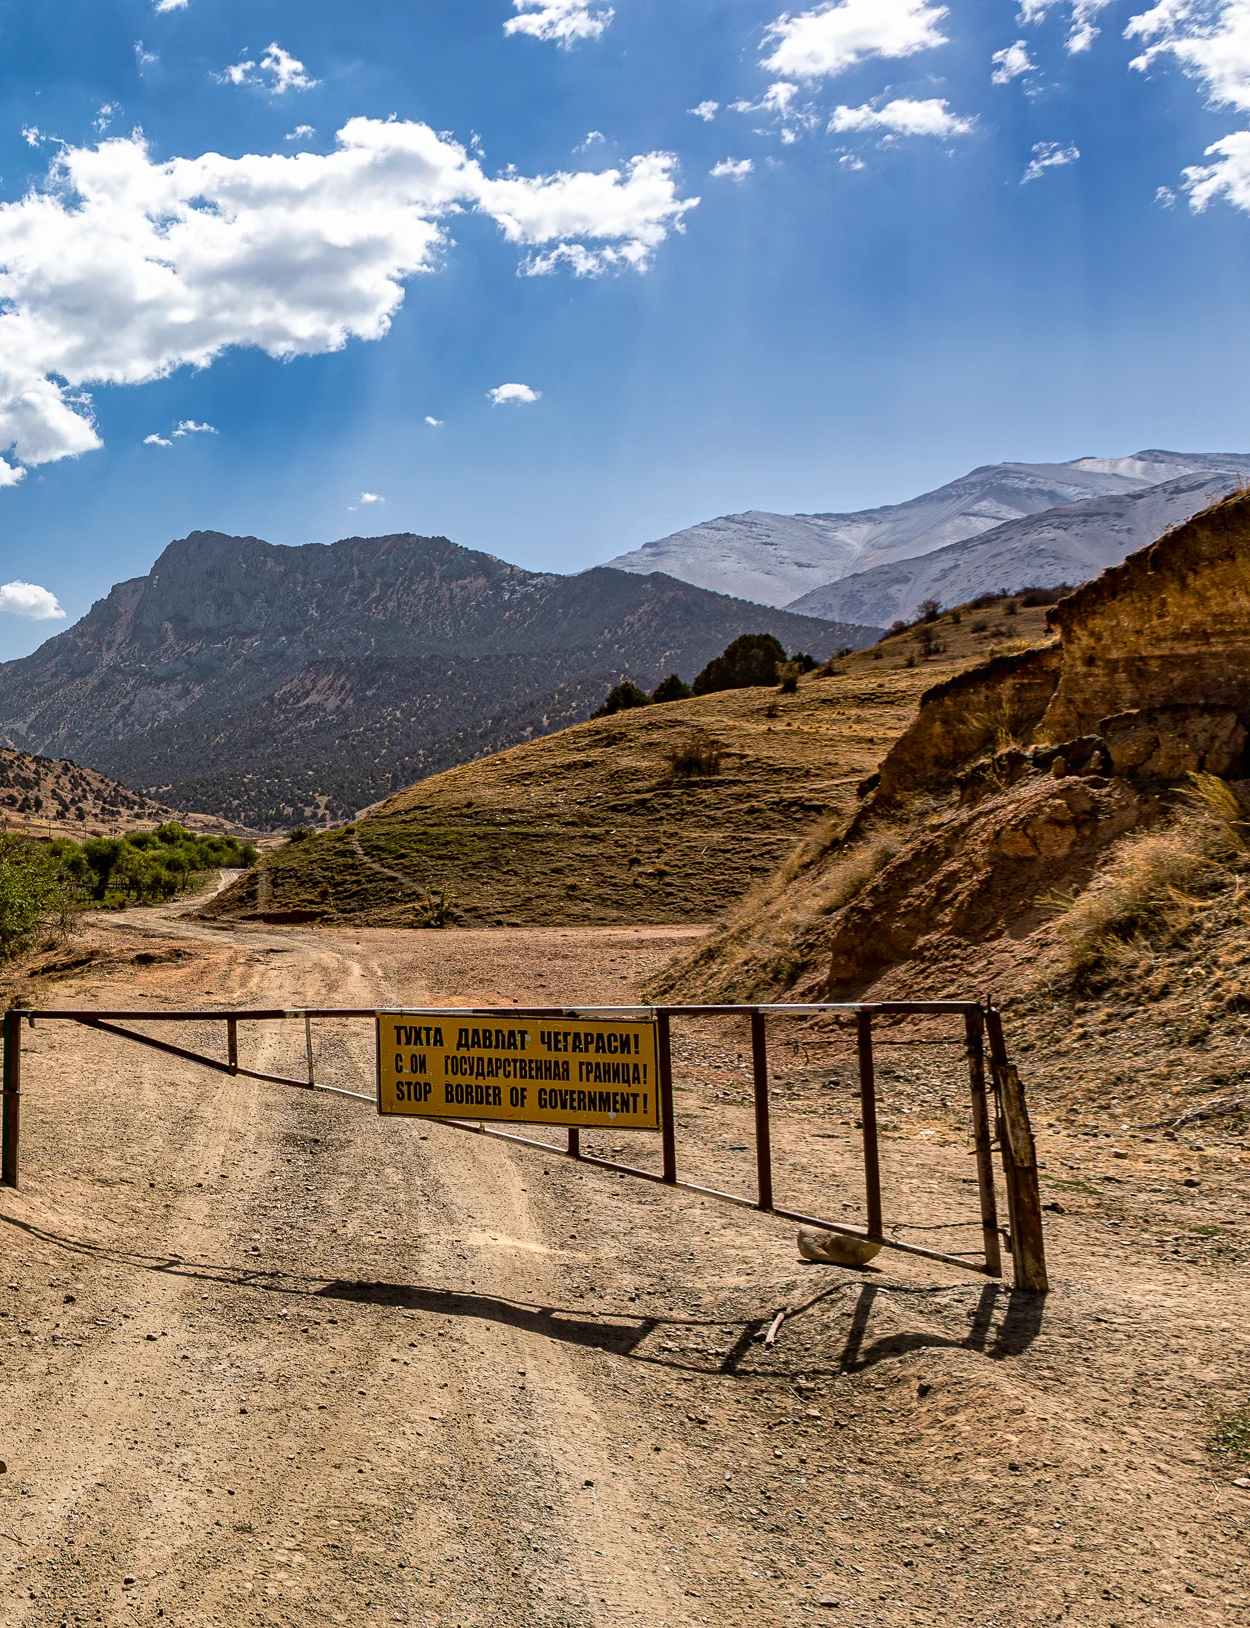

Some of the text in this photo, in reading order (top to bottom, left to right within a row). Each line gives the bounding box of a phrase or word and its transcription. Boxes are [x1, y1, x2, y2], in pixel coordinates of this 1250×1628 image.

[393, 1025, 640, 1055] ТУХТА ДАВЛАТ ЧЕГАРАСИ!
[444, 1055, 570, 1081] ГОСУДАРСТВЕННАЯ
[578, 1061, 648, 1087] ГРАНИЦА!
[395, 1080, 432, 1102] STOP
[444, 1082, 502, 1106] BORDER
[510, 1086, 527, 1108] OF
